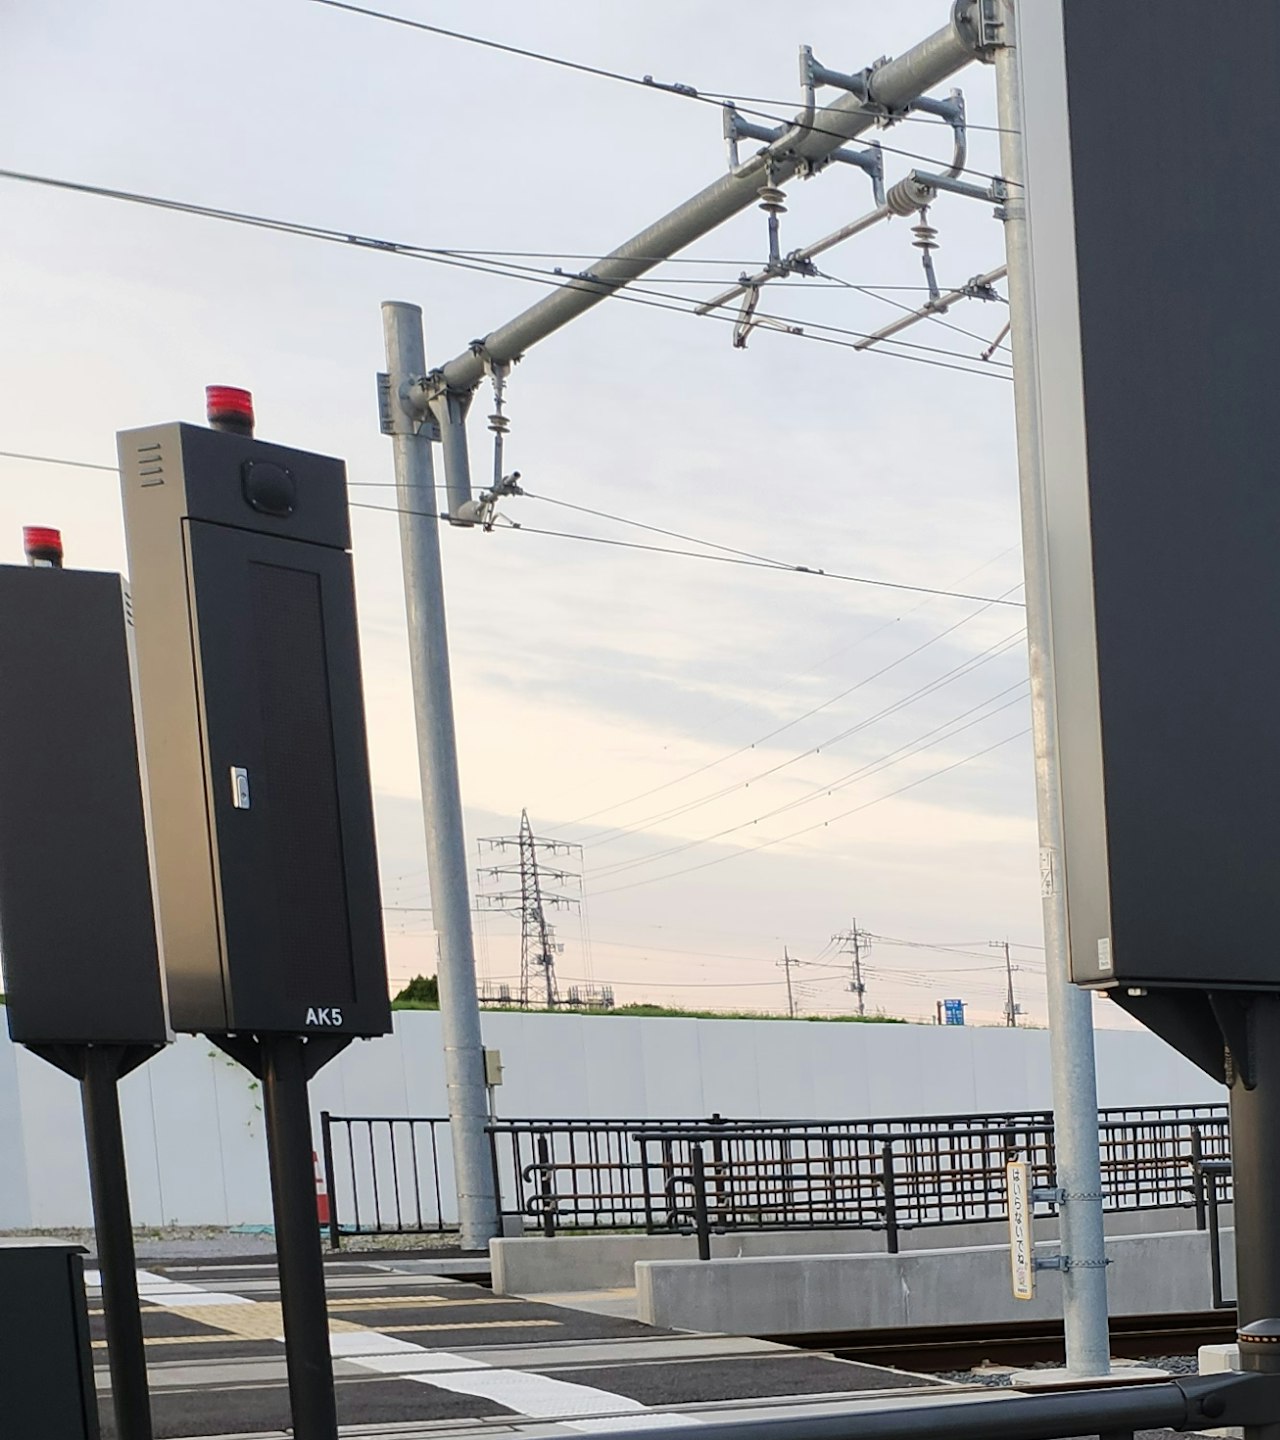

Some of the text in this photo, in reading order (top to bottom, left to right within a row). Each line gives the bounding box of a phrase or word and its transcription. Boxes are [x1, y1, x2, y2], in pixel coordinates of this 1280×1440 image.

[305, 1007, 343, 1026] AK5
[1012, 1168, 1025, 1265] はいらないでね
